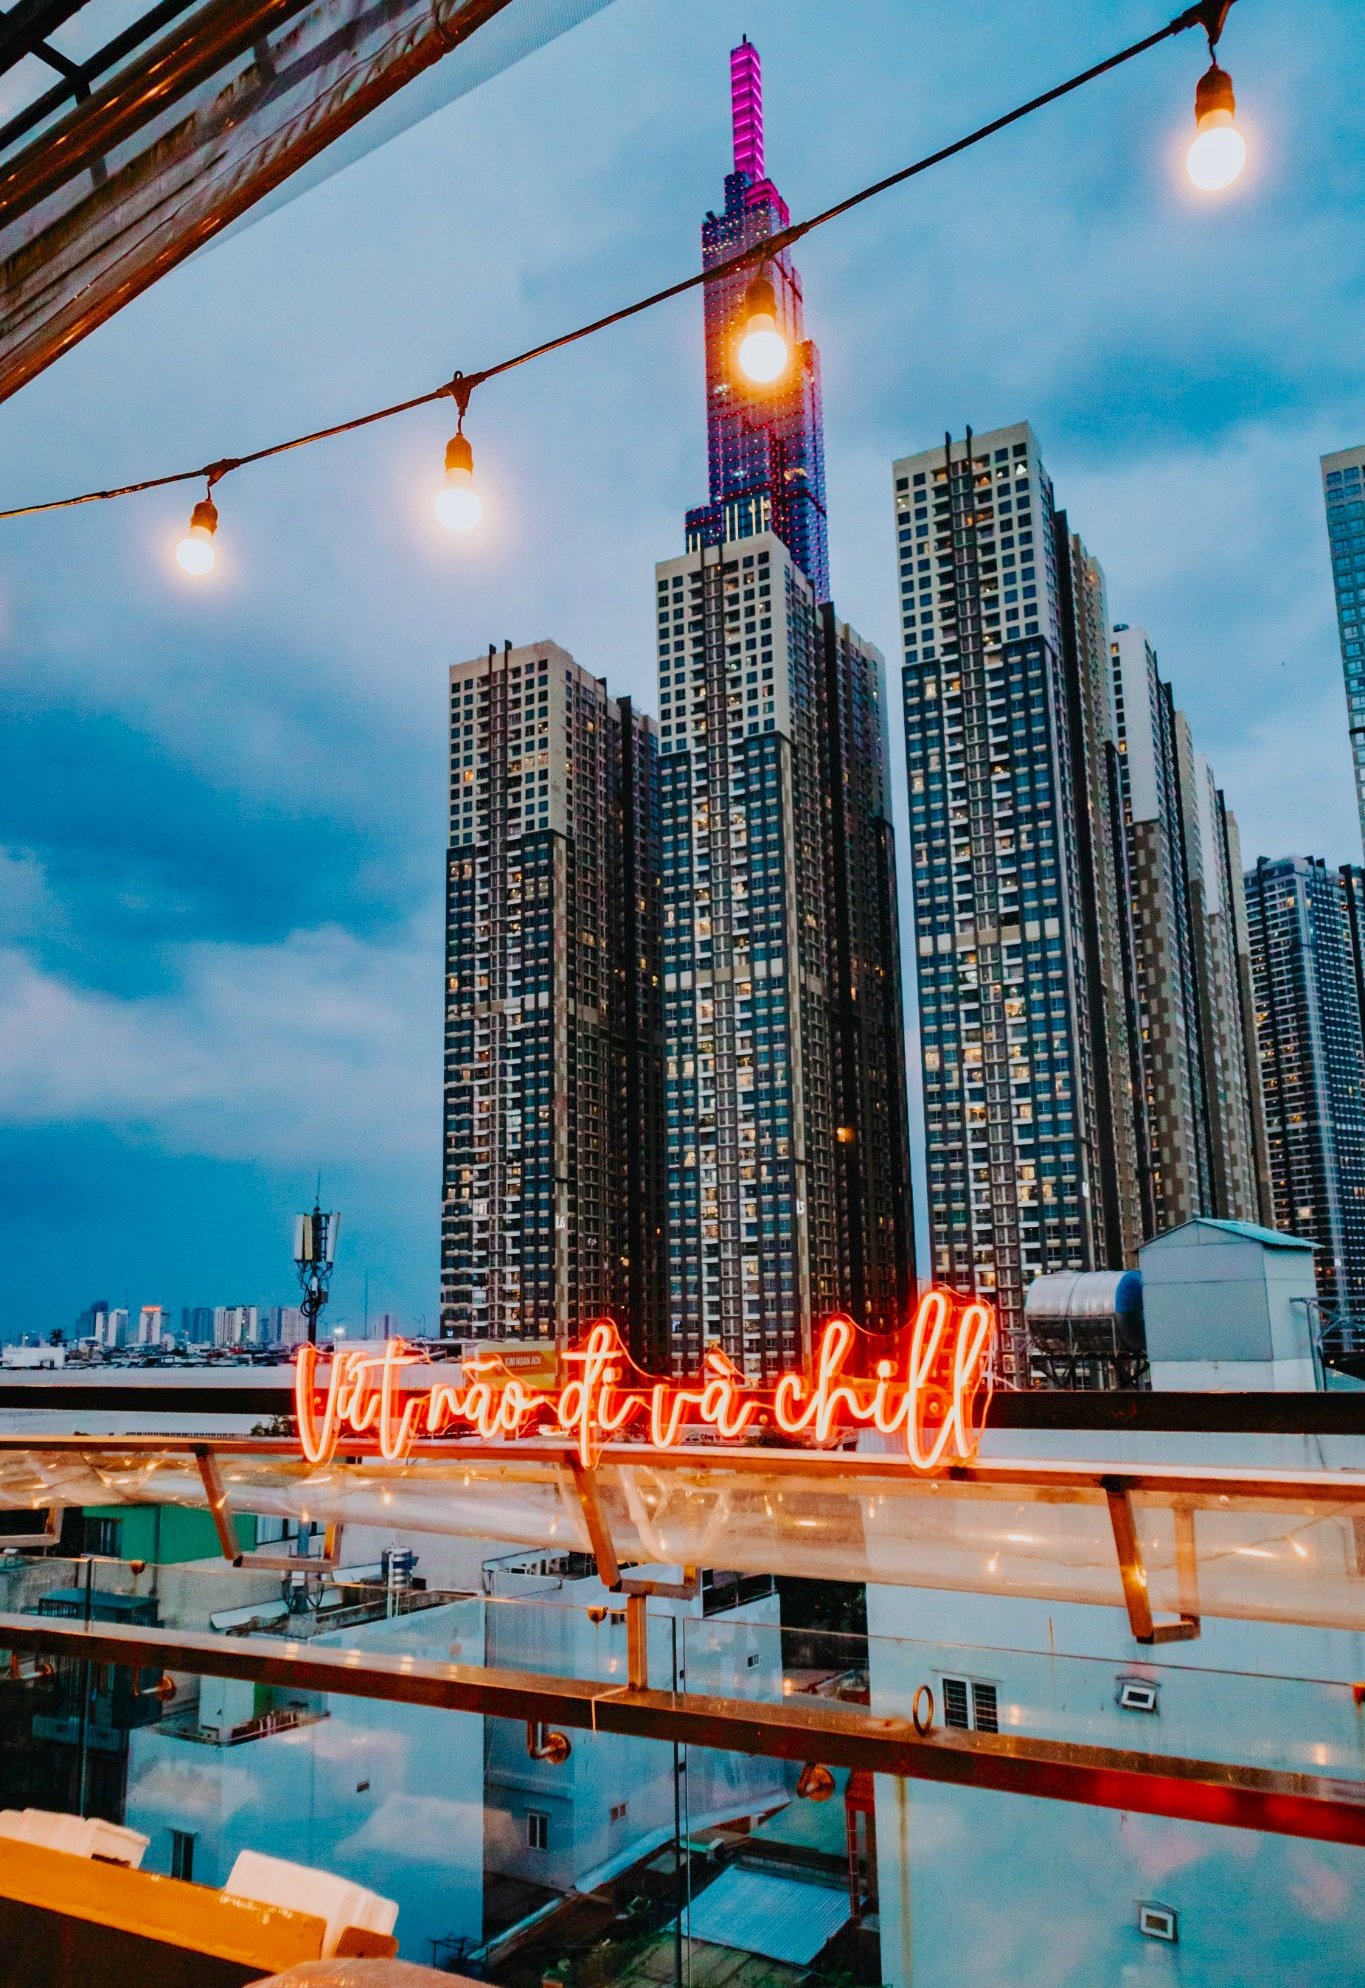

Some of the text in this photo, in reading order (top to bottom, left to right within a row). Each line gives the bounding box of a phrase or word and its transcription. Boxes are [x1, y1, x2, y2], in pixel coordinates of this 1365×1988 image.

[426, 1359, 548, 1438] não
[559, 1325, 644, 1467] đi
[652, 1353, 757, 1448] và
[775, 1292, 989, 1468] chill
